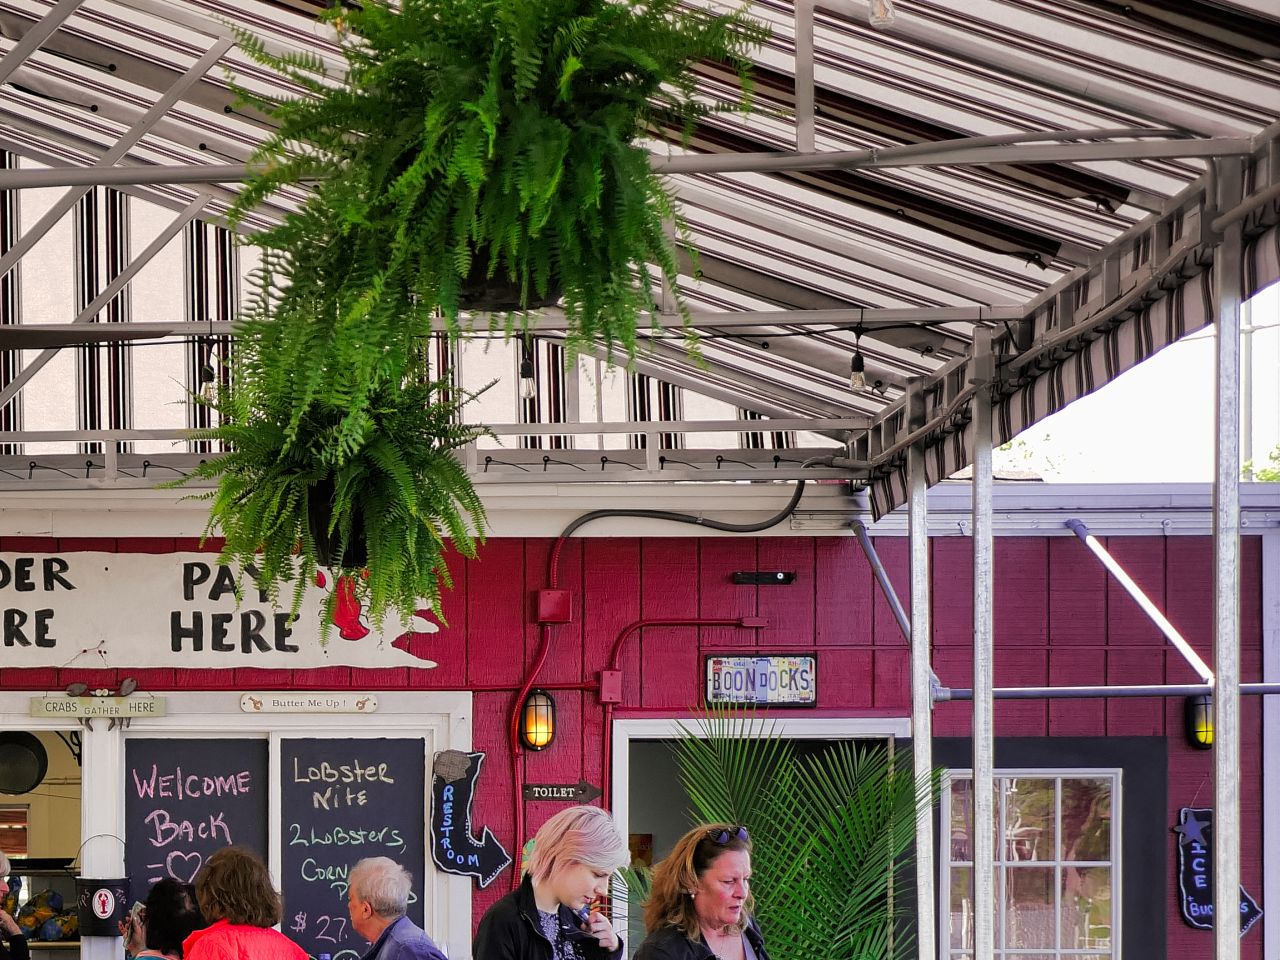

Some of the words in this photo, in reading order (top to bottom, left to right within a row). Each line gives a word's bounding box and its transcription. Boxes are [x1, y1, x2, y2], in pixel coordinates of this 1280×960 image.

[170, 609, 301, 654] HERE
[713, 668, 809, 692] BOONDOCKS
[45, 702, 78, 712] CRABS
[84, 707, 120, 715] GATHER
[129, 702, 155, 712] HERE
[272, 699, 305, 707] Butter
[307, 699, 322, 707] Me
[326, 699, 340, 709] Up
[532, 787, 575, 797] TOILET
[440, 784, 480, 867] RESTROOM
[1190, 842, 1207, 888] ICE
